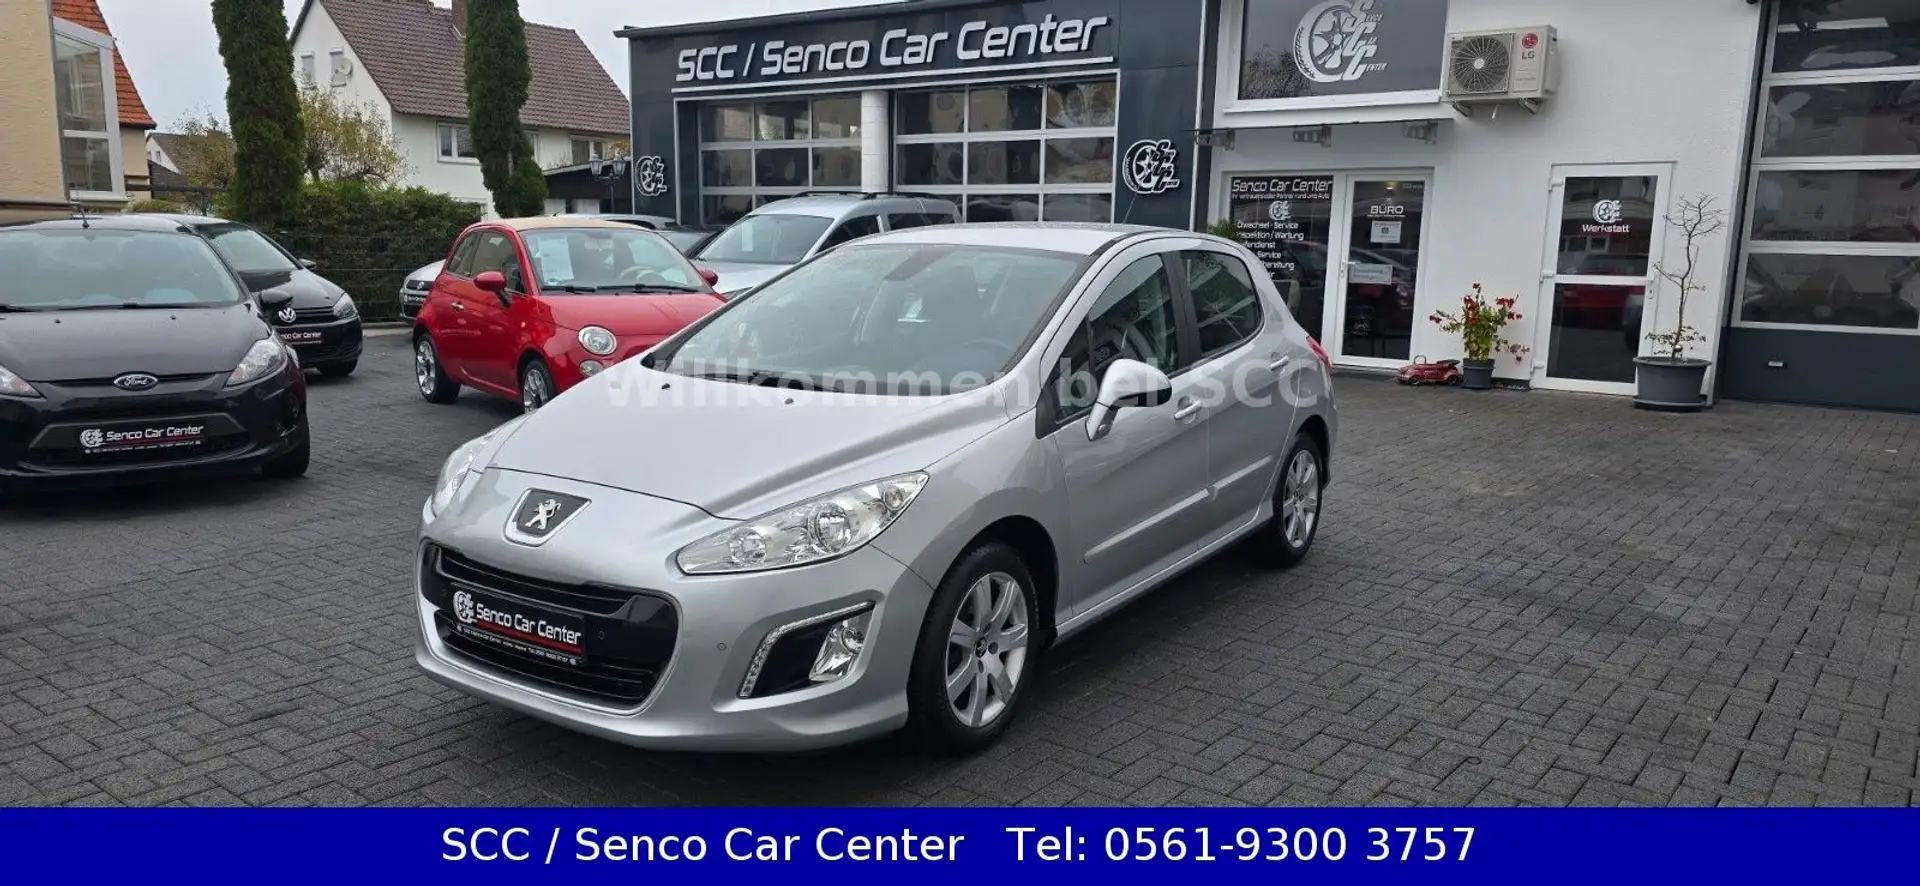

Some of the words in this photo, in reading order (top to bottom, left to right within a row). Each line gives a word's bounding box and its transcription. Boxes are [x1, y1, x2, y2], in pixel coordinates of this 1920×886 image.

[676, 44, 738, 82] SCC
[742, 42, 755, 76] /
[761, 40, 870, 76] Senco
[880, 28, 949, 66] Car
[957, 14, 1107, 60] Center
[1521, 51, 1535, 60] LG
[1232, 179, 1267, 192] Senco
[1269, 179, 1290, 192] Car
[1292, 178, 1333, 192] Center
[1370, 203, 1404, 215] BÜRO
[1274, 221, 1299, 229] Service
[1582, 224, 1630, 233] Werkstatt
[1274, 231, 1305, 241] Wartung
[106, 430, 143, 441] Senco
[144, 428, 165, 438] Car
[166, 425, 204, 437] Center
[476, 603, 512, 628] Senco
[514, 613, 536, 633] Car
[537, 620, 581, 645] Center
